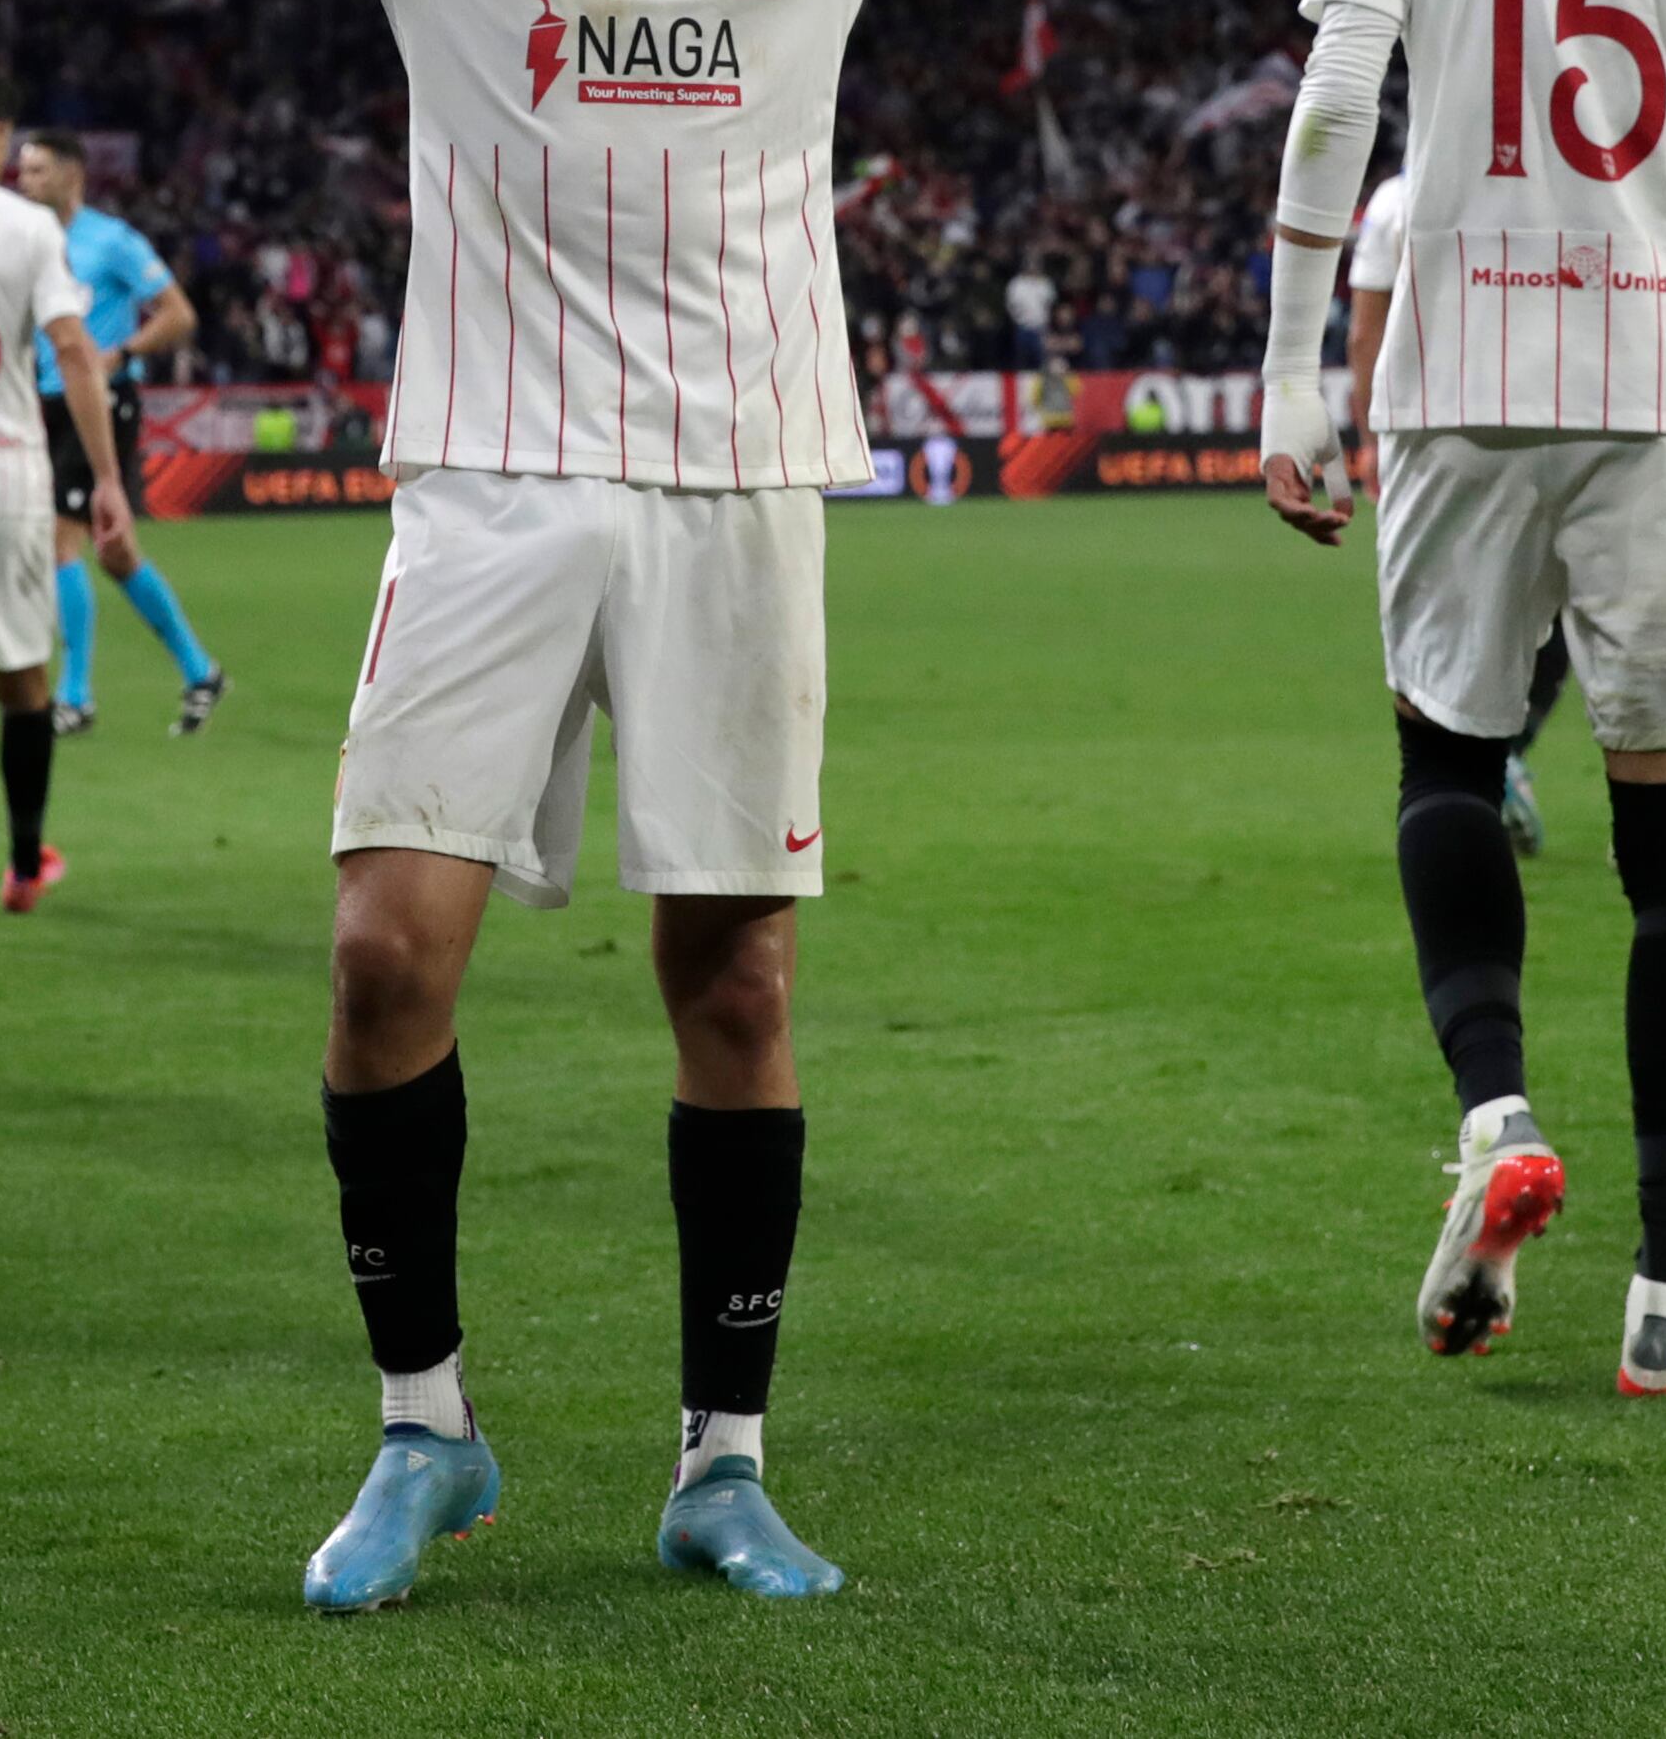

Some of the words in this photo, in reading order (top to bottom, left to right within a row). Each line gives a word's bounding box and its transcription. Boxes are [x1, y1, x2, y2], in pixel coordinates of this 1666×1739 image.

[578, 15, 741, 79] NAGA
[585, 86, 614, 99] Your
[617, 89, 674, 102] Investing
[677, 89, 710, 103] Super
[712, 90, 735, 104] App
[1471, 267, 1556, 289] Manos
[728, 1289, 782, 1310] SFC
